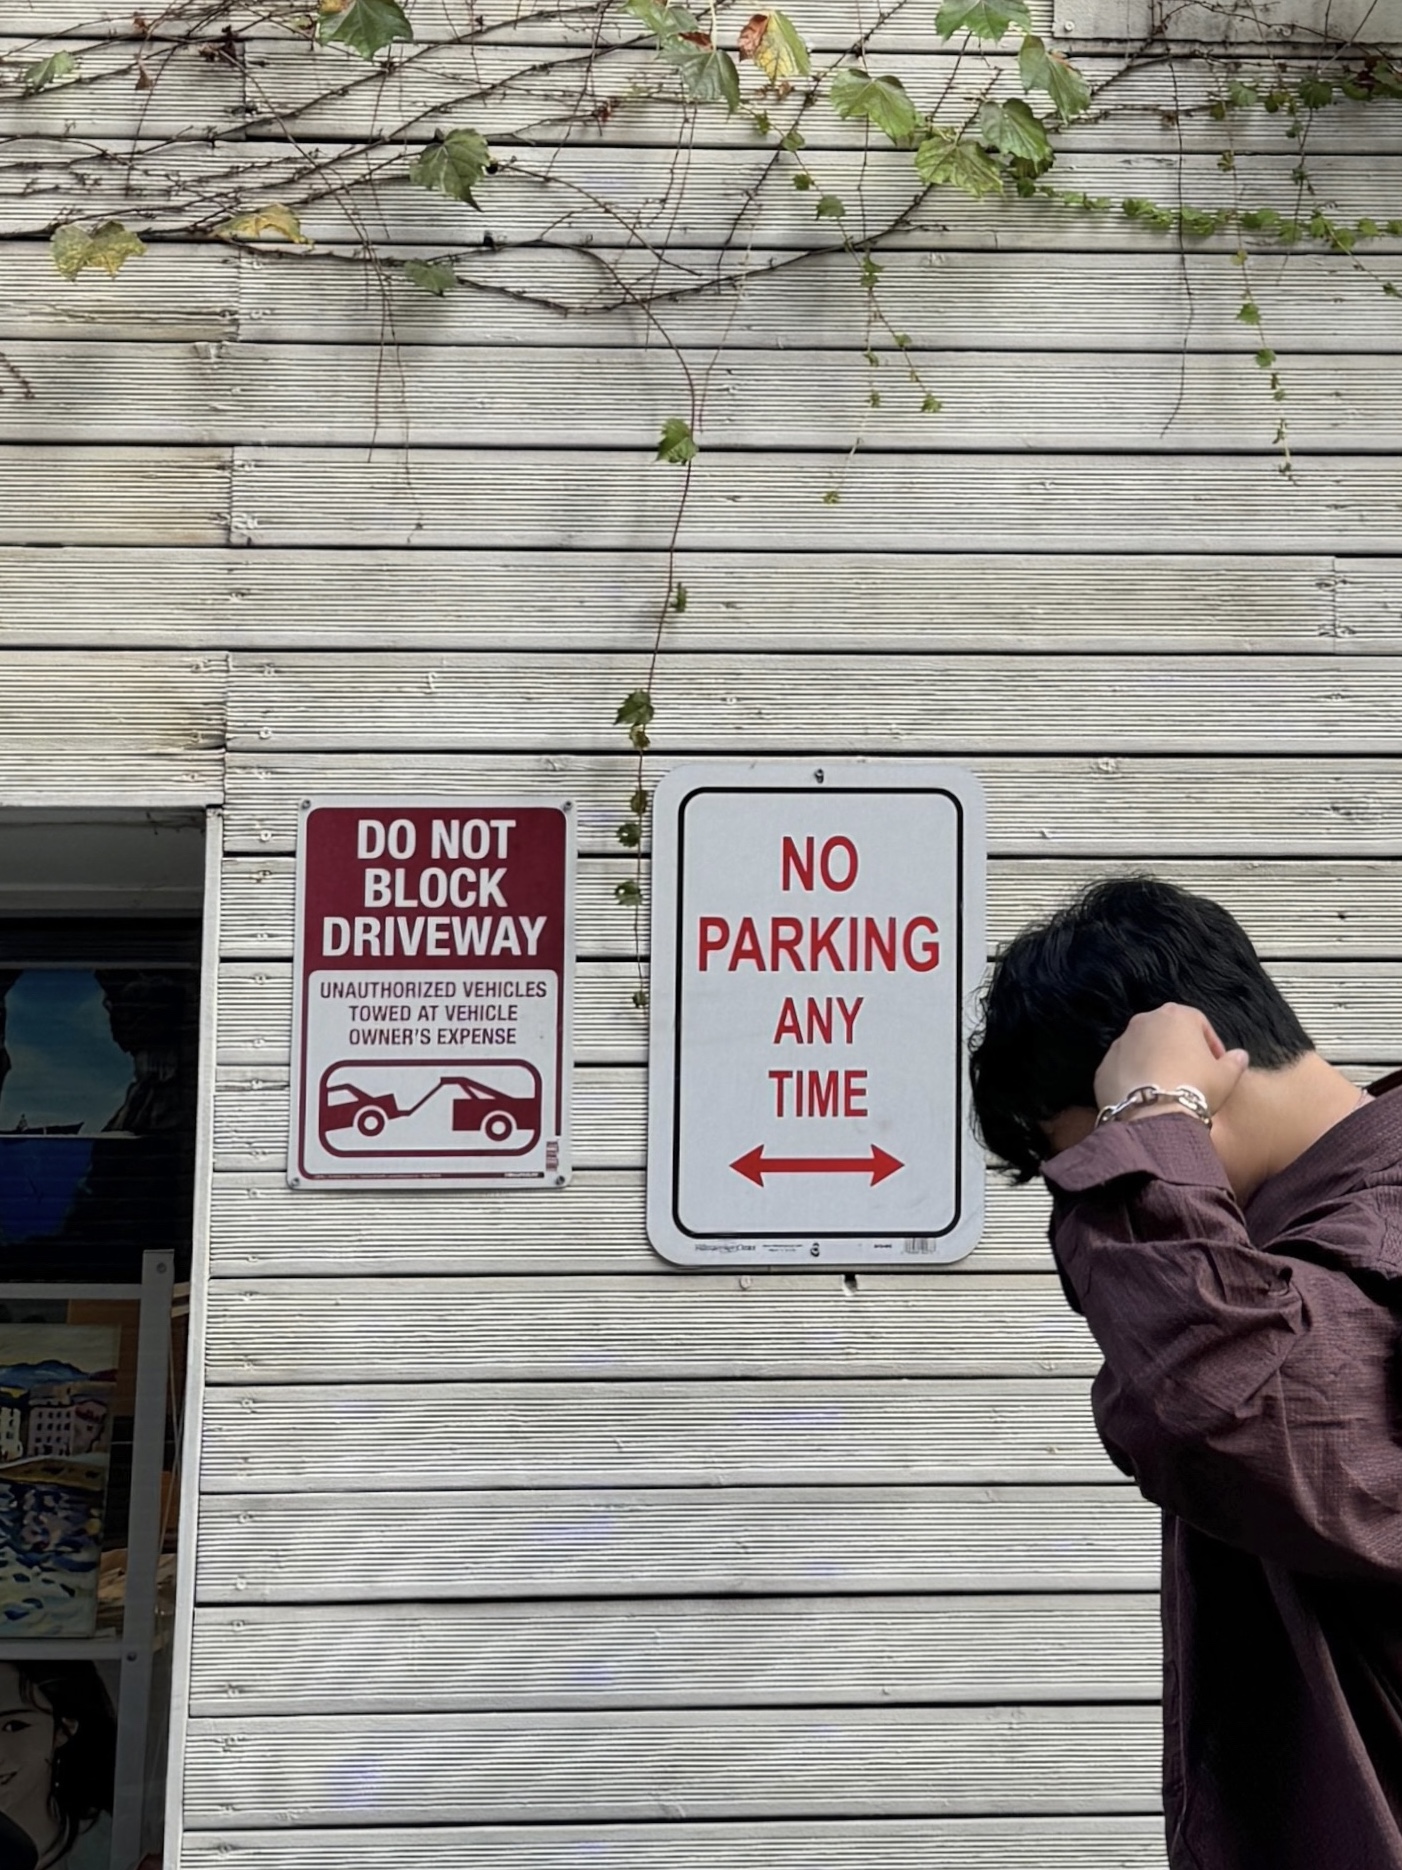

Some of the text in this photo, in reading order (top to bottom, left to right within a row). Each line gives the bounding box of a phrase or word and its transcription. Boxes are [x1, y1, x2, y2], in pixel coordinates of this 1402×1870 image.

[357, 818, 517, 860] DO NOT
[782, 835, 859, 892] NO
[363, 866, 509, 909] BLOCK
[321, 915, 548, 957] DRIVEWAY
[698, 916, 940, 973] PARKING
[320, 980, 548, 999] UNAUTHORIZED VEHICLES
[349, 1004, 518, 1022] TOWED AT VEHICLE
[773, 996, 865, 1045] ANY
[349, 1028, 517, 1045] OWNER'S EXPENSE
[768, 1070, 868, 1118] TIME
